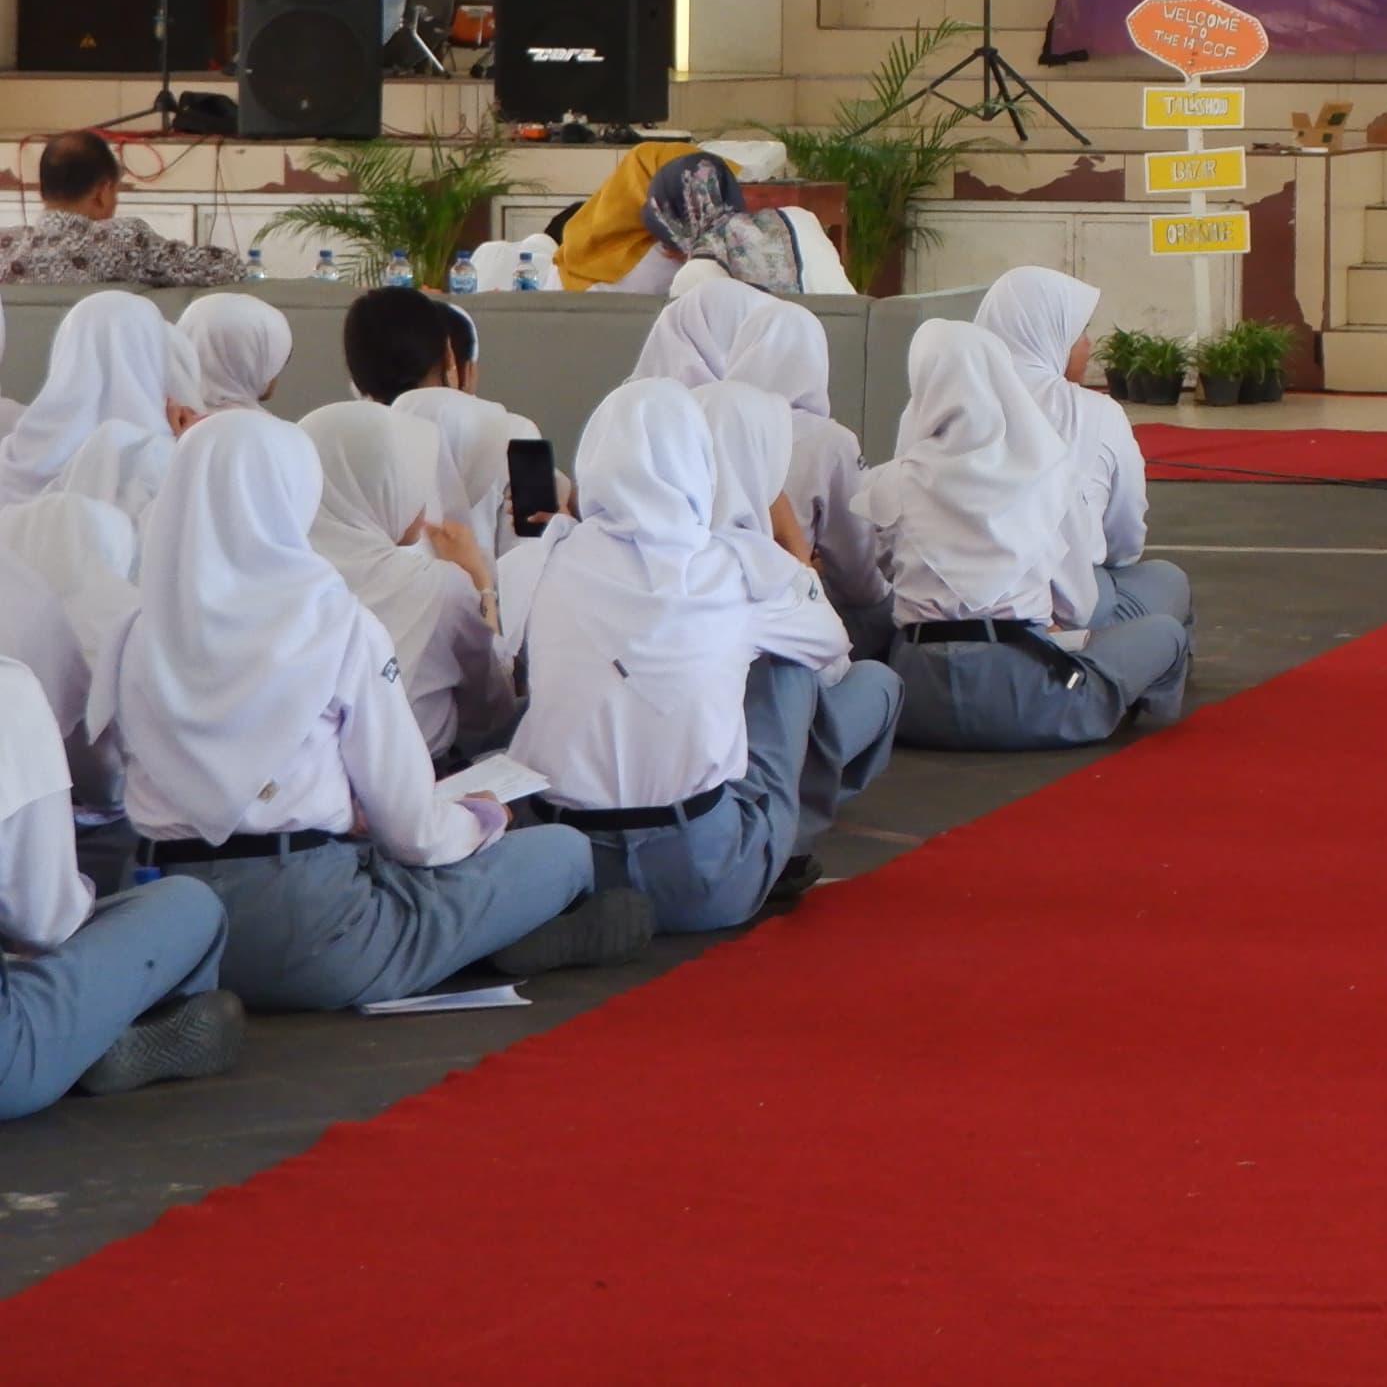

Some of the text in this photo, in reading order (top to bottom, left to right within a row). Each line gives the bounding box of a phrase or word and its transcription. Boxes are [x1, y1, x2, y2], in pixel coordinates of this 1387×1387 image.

[1163, 3, 1241, 32] WELCOME
[1187, 24, 1208, 39] TO
[1154, 29, 1179, 46] THE
[1202, 40, 1238, 58] CCF
